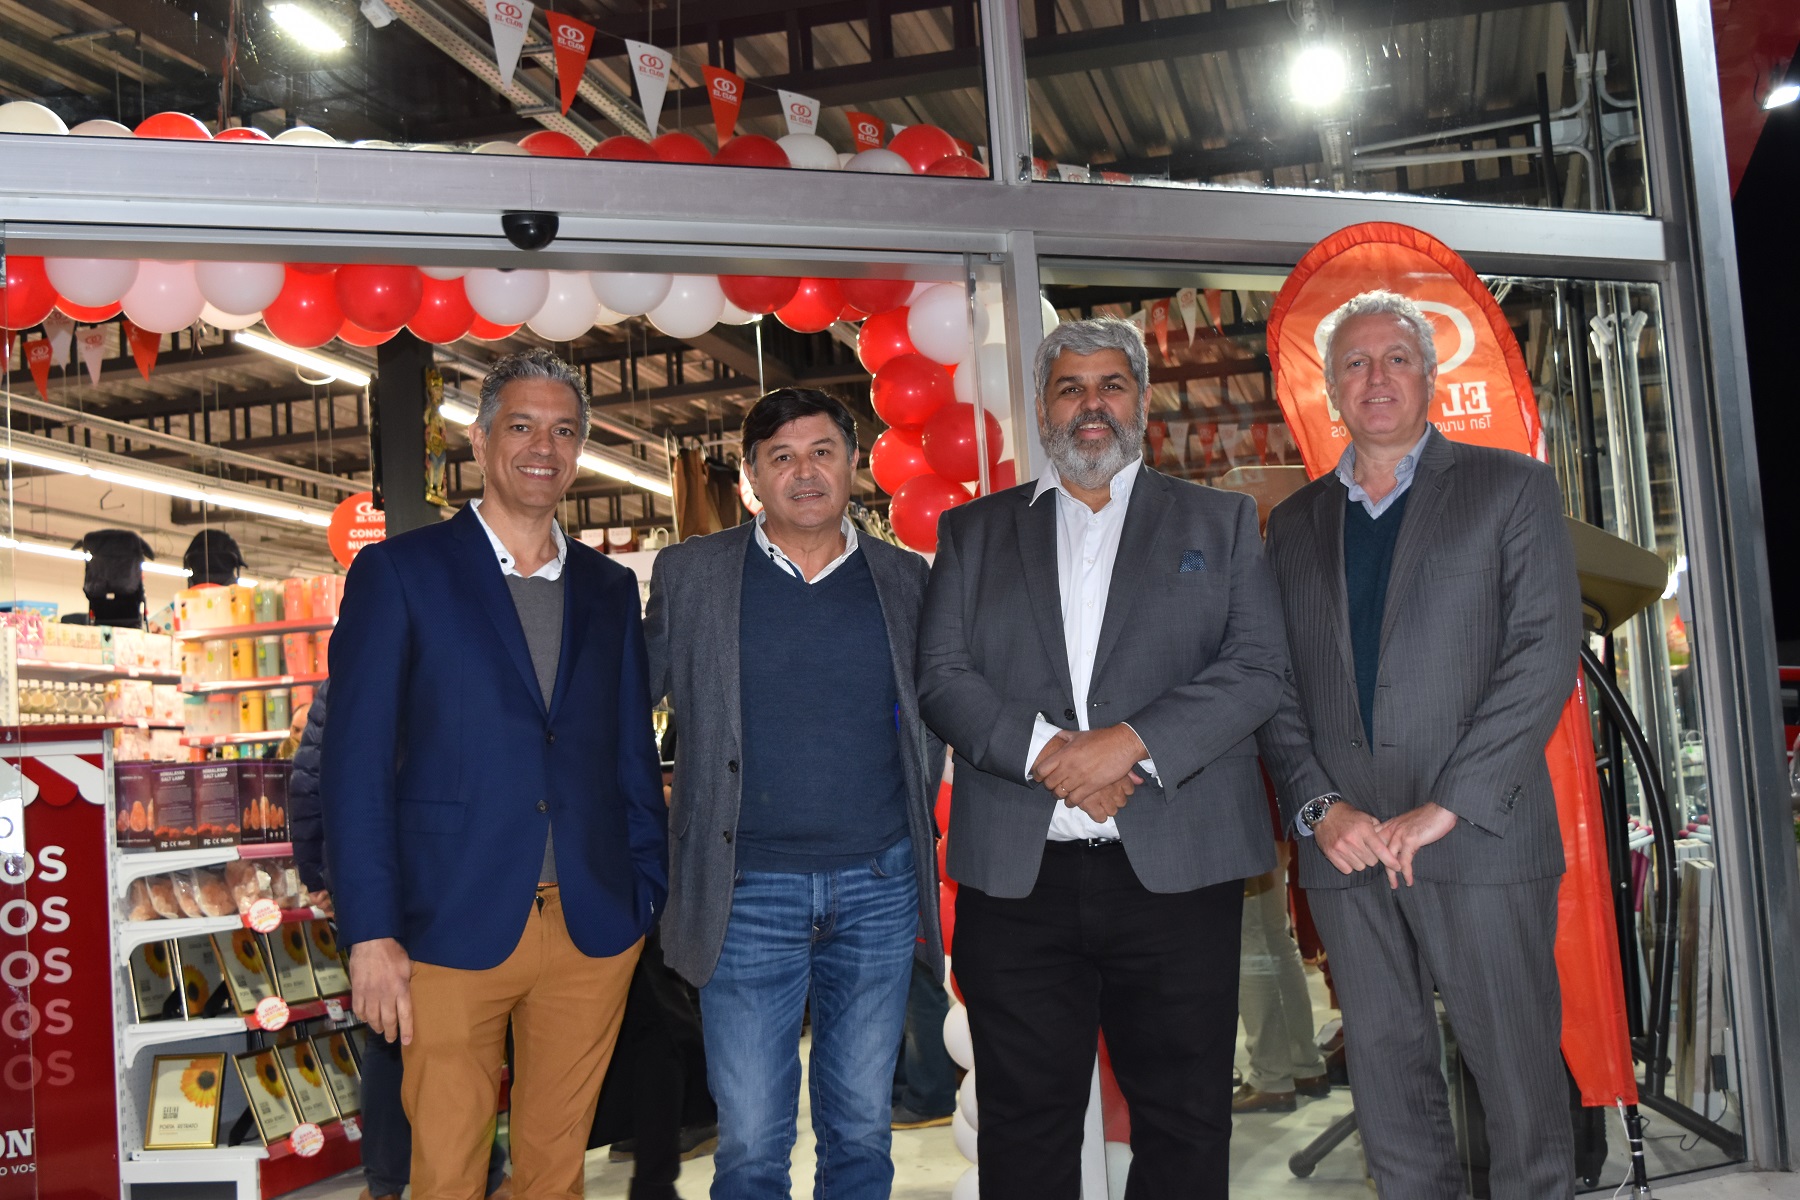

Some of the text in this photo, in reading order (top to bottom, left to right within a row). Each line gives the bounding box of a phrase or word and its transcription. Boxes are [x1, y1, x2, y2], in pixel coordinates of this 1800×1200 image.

[495, 13, 504, 21] EL
[505, 17, 524, 29] CLON
[558, 36, 566, 45] EL
[567, 40, 586, 52] CLON
[639, 65, 647, 73] EL
[649, 68, 665, 79] CLON
[712, 89, 721, 97] EL
[722, 92, 738, 102] CLON
[356, 515, 367, 523] EL
[11, 1162, 37, 1175] VOS
